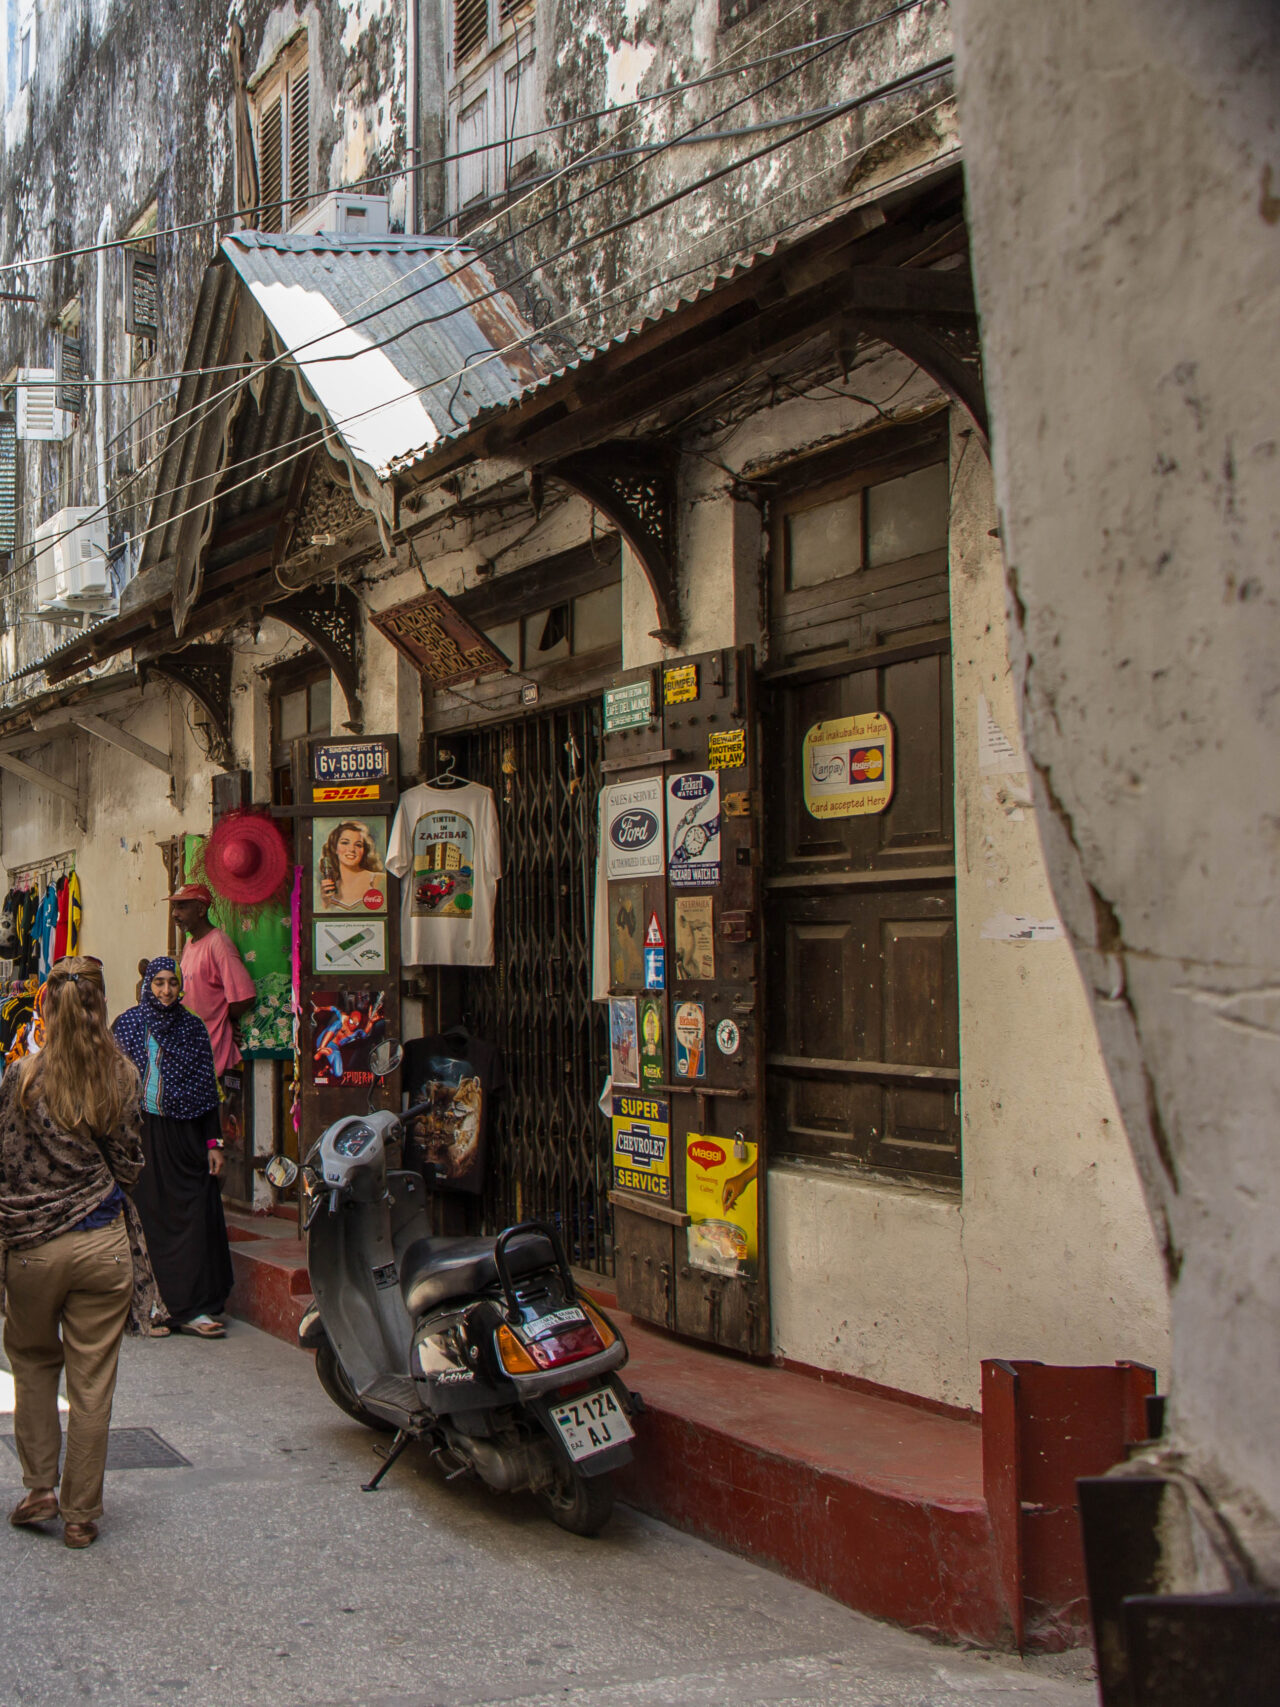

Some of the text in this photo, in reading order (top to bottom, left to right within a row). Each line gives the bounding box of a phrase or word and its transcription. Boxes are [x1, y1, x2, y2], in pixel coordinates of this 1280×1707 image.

[388, 603, 446, 636] ZANZIBAR
[409, 623, 447, 647] CURIO
[425, 639, 459, 662] SHOP
[467, 646, 495, 667] STR
[666, 677, 696, 691] BUMPER
[712, 734, 742, 746] BEWARE
[808, 723, 887, 744] Kadi inakubalika Hapa
[712, 743, 742, 755] MOTHER
[712, 752, 742, 765] IN-LAW
[334, 771, 369, 779] HAWAII
[681, 776, 704, 791] Packard
[323, 788, 369, 800] DHL
[610, 793, 628, 806] SALES
[633, 789, 658, 803] SERVICE
[677, 788, 707, 797] WATCHES
[810, 796, 886, 813] Card accepted Here
[432, 816, 456, 824] TINTIN
[419, 831, 468, 841] ZANZIBAR
[618, 815, 648, 843] Ford
[669, 868, 691, 881] PACKARD
[692, 868, 711, 880] WATCH
[341, 1071, 385, 1085] SPIDER-MN
[621, 1097, 659, 1120] SUPER
[618, 1133, 665, 1157] CHEVROLET
[692, 1147, 722, 1162] Maggi
[618, 1169, 668, 1194] SERVICE
[437, 1371, 475, 1384] Activa
[587, 1422, 613, 1447] AJ
